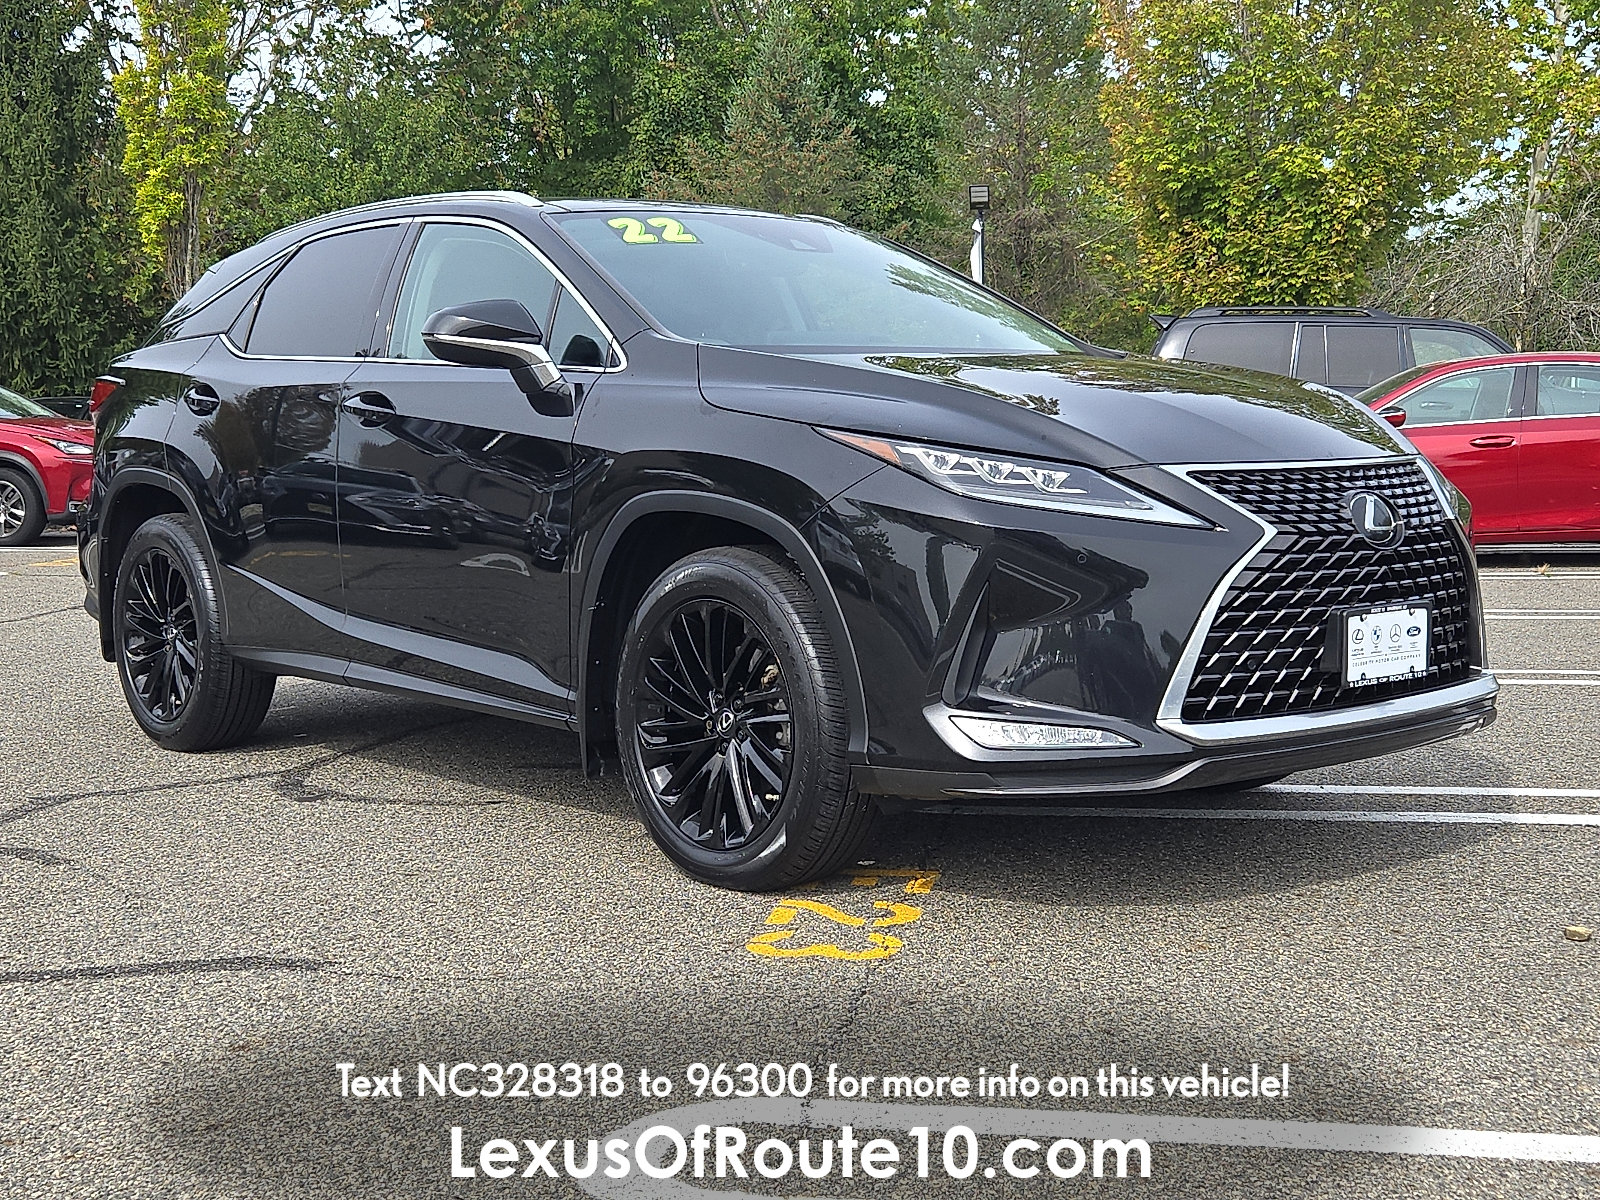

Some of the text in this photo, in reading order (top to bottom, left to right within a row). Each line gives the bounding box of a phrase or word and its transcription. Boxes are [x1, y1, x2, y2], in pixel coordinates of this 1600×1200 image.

[607, 216, 699, 244] 22
[1354, 678, 1378, 688] LEXUS
[1389, 672, 1413, 682] ROUTE
